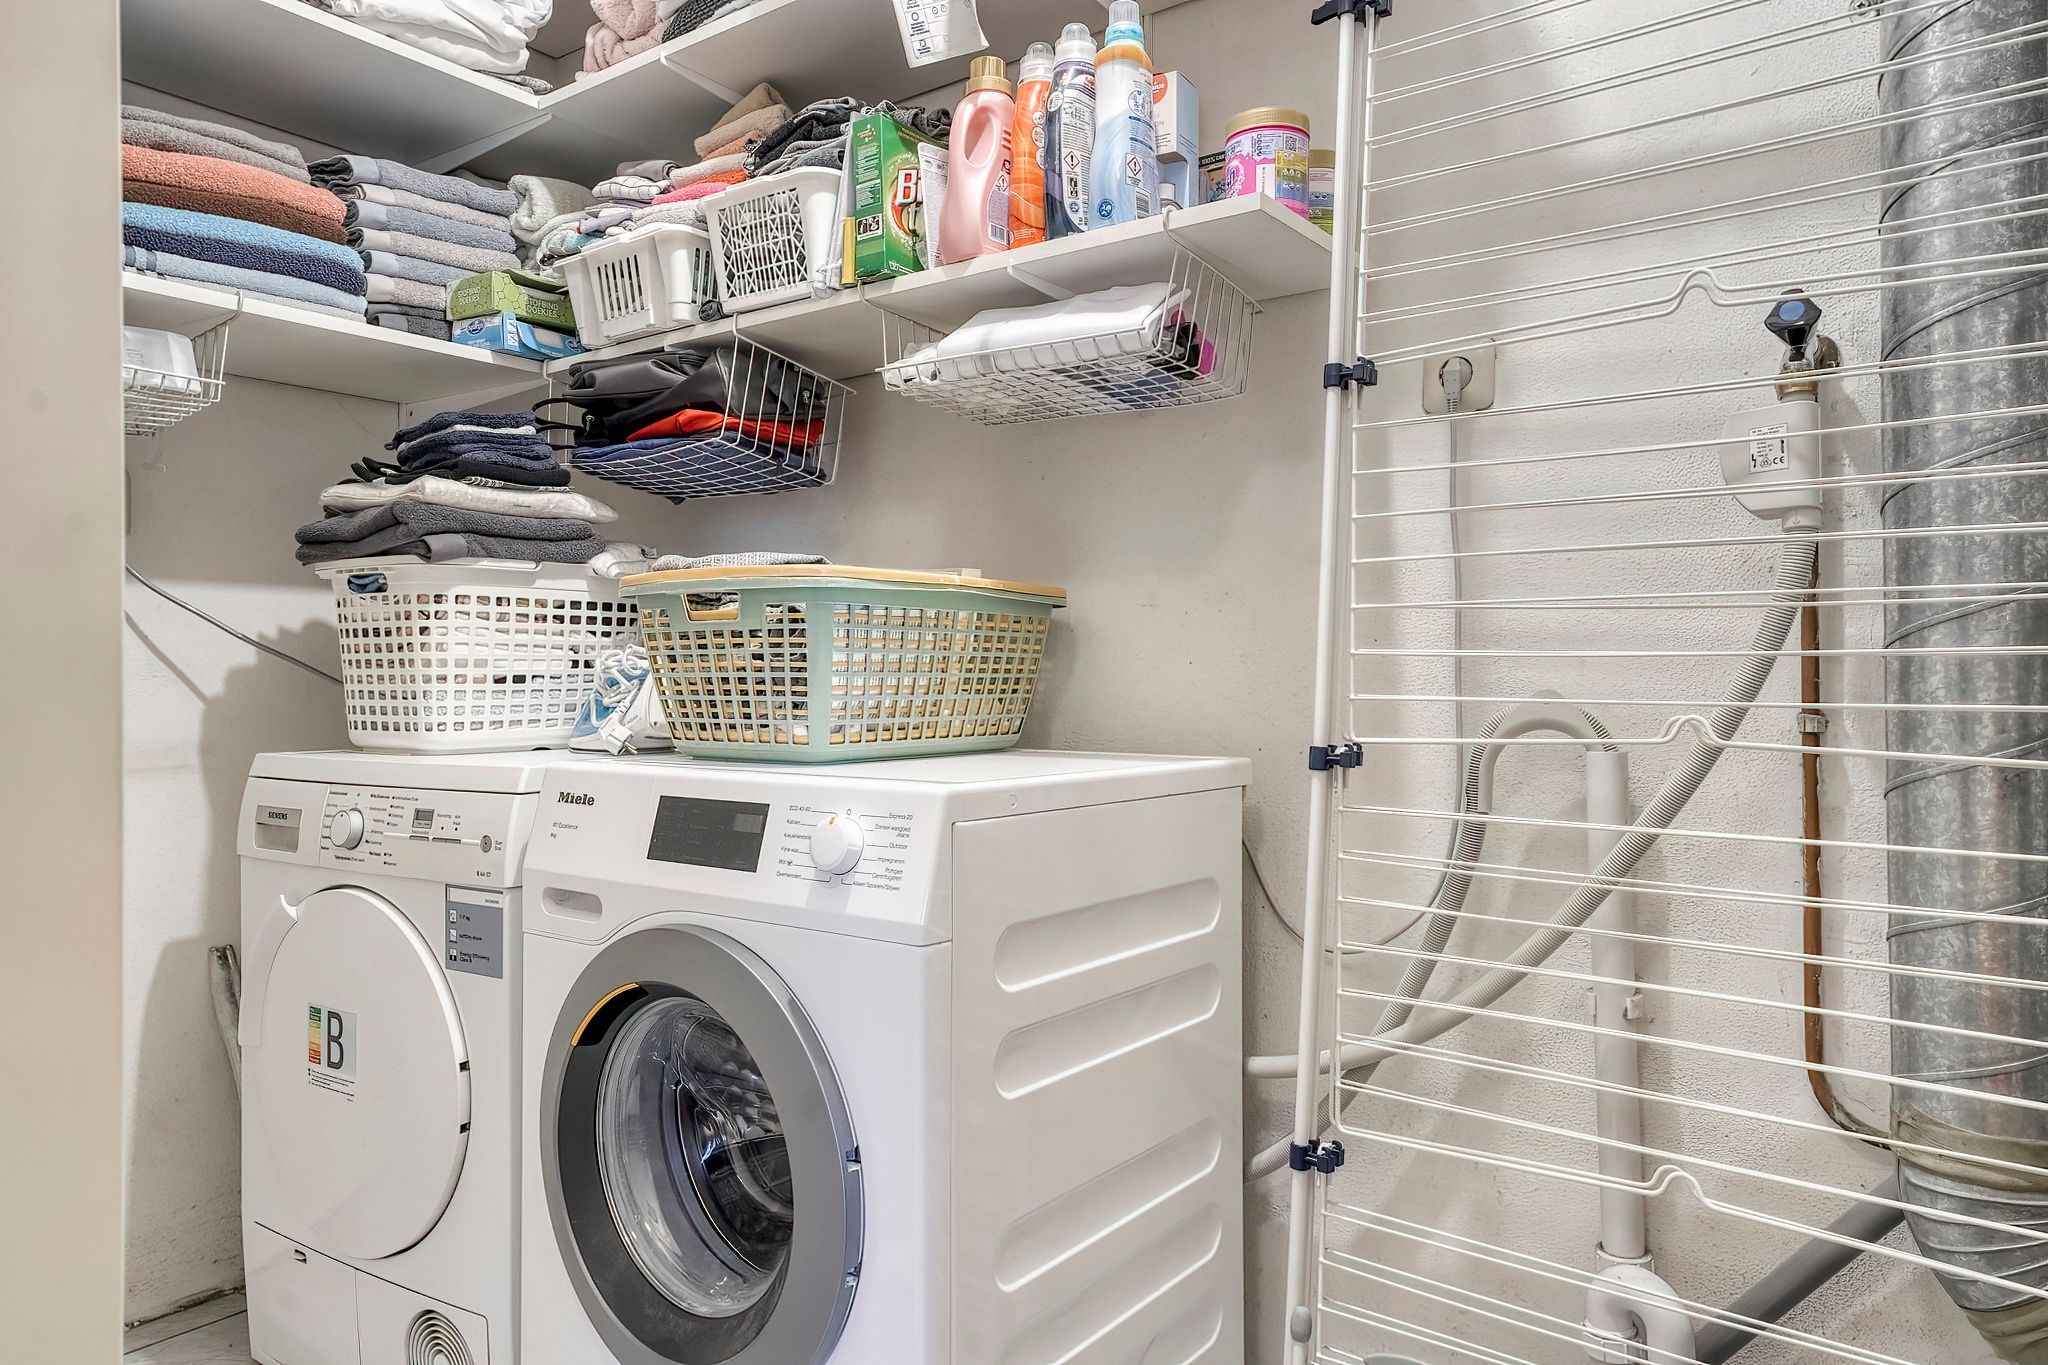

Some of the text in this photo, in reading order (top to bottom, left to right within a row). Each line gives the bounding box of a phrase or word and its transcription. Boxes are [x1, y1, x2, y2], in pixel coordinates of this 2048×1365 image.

[457, 286, 481, 298] STOFBIND
[458, 295, 480, 306] DOEKJES
[524, 297, 559, 311] STOFBIND
[526, 305, 558, 318] DOEKJES
[557, 791, 595, 806] Miele
[889, 812, 906, 820] Express
[874, 823, 891, 831] Donker
[889, 842, 909, 850] Outdoor
[885, 867, 904, 875] Pompen
[872, 872, 902, 882] Centrifugeren
[327, 1010, 344, 1069] B
